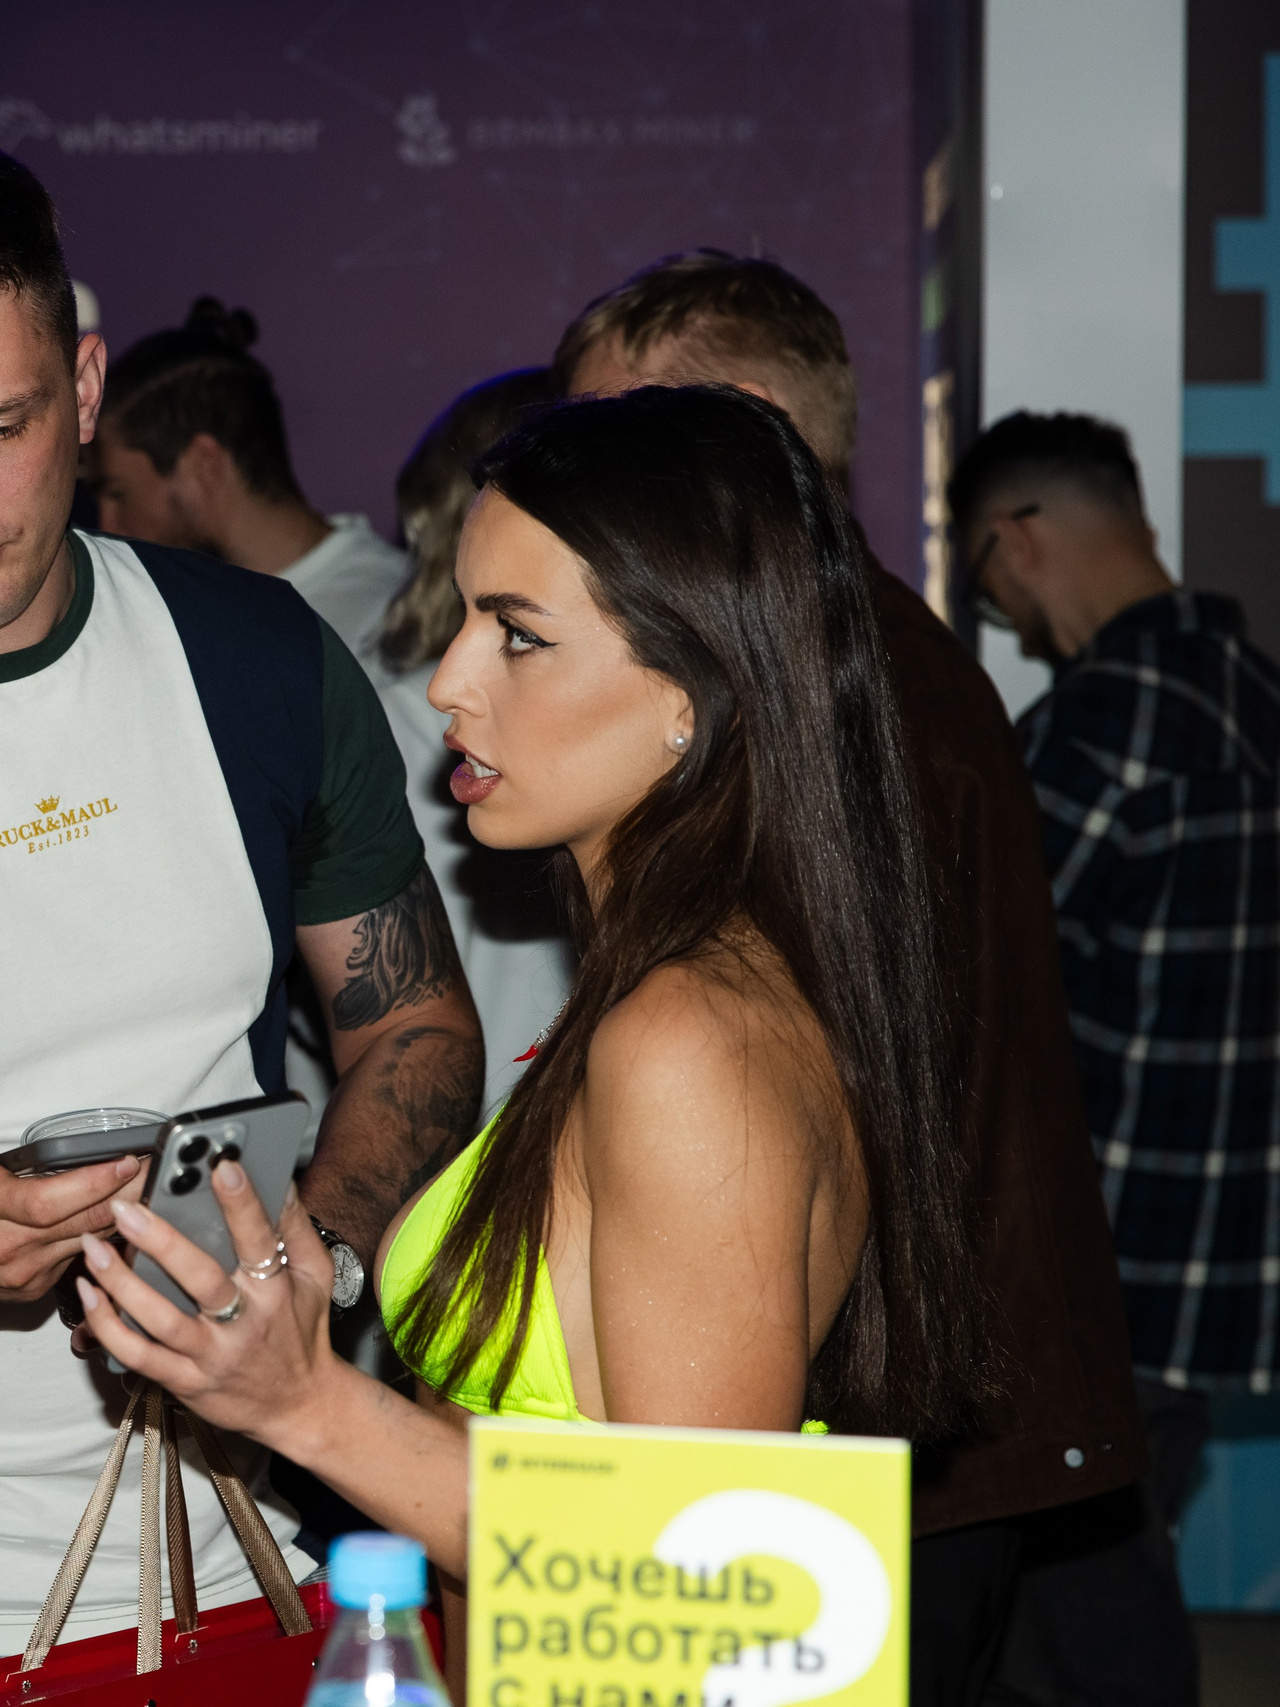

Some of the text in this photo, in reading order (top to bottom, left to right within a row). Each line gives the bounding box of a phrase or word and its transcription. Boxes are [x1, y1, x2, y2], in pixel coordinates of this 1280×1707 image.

[57, 113, 322, 154] whatsminer
[494, 1533, 776, 1606] Хочешь
[491, 1603, 825, 1675] работать
